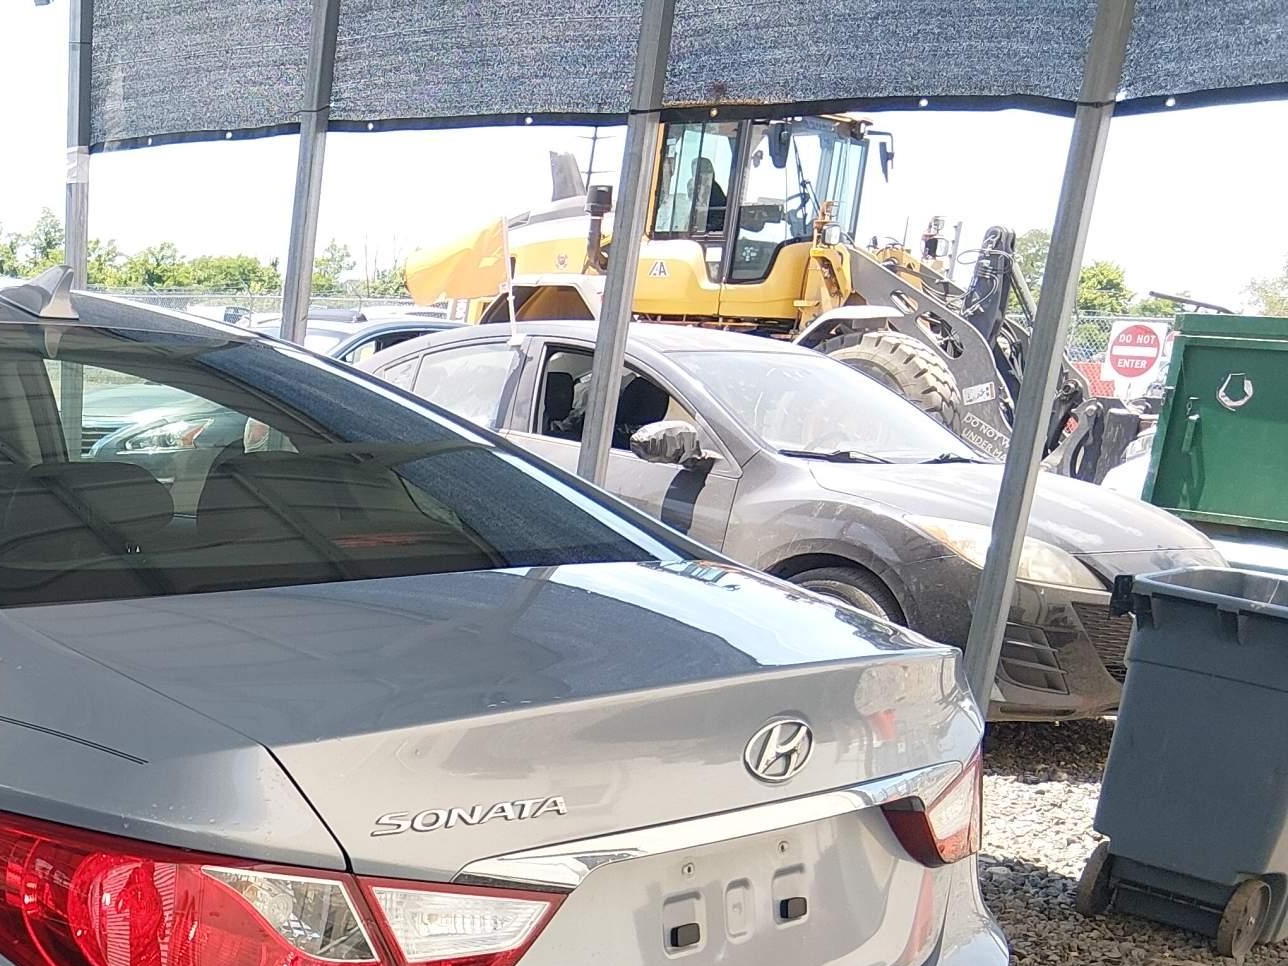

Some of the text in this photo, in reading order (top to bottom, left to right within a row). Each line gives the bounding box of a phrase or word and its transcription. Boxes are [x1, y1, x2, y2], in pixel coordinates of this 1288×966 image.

[1119, 334, 1156, 344] DO NOT
[1118, 359, 1147, 368] ENTER
[962, 428, 993, 453] UNDER
[964, 415, 979, 428] DO
[979, 424, 1001, 441] NOT
[370, 795, 568, 838] SONATA
